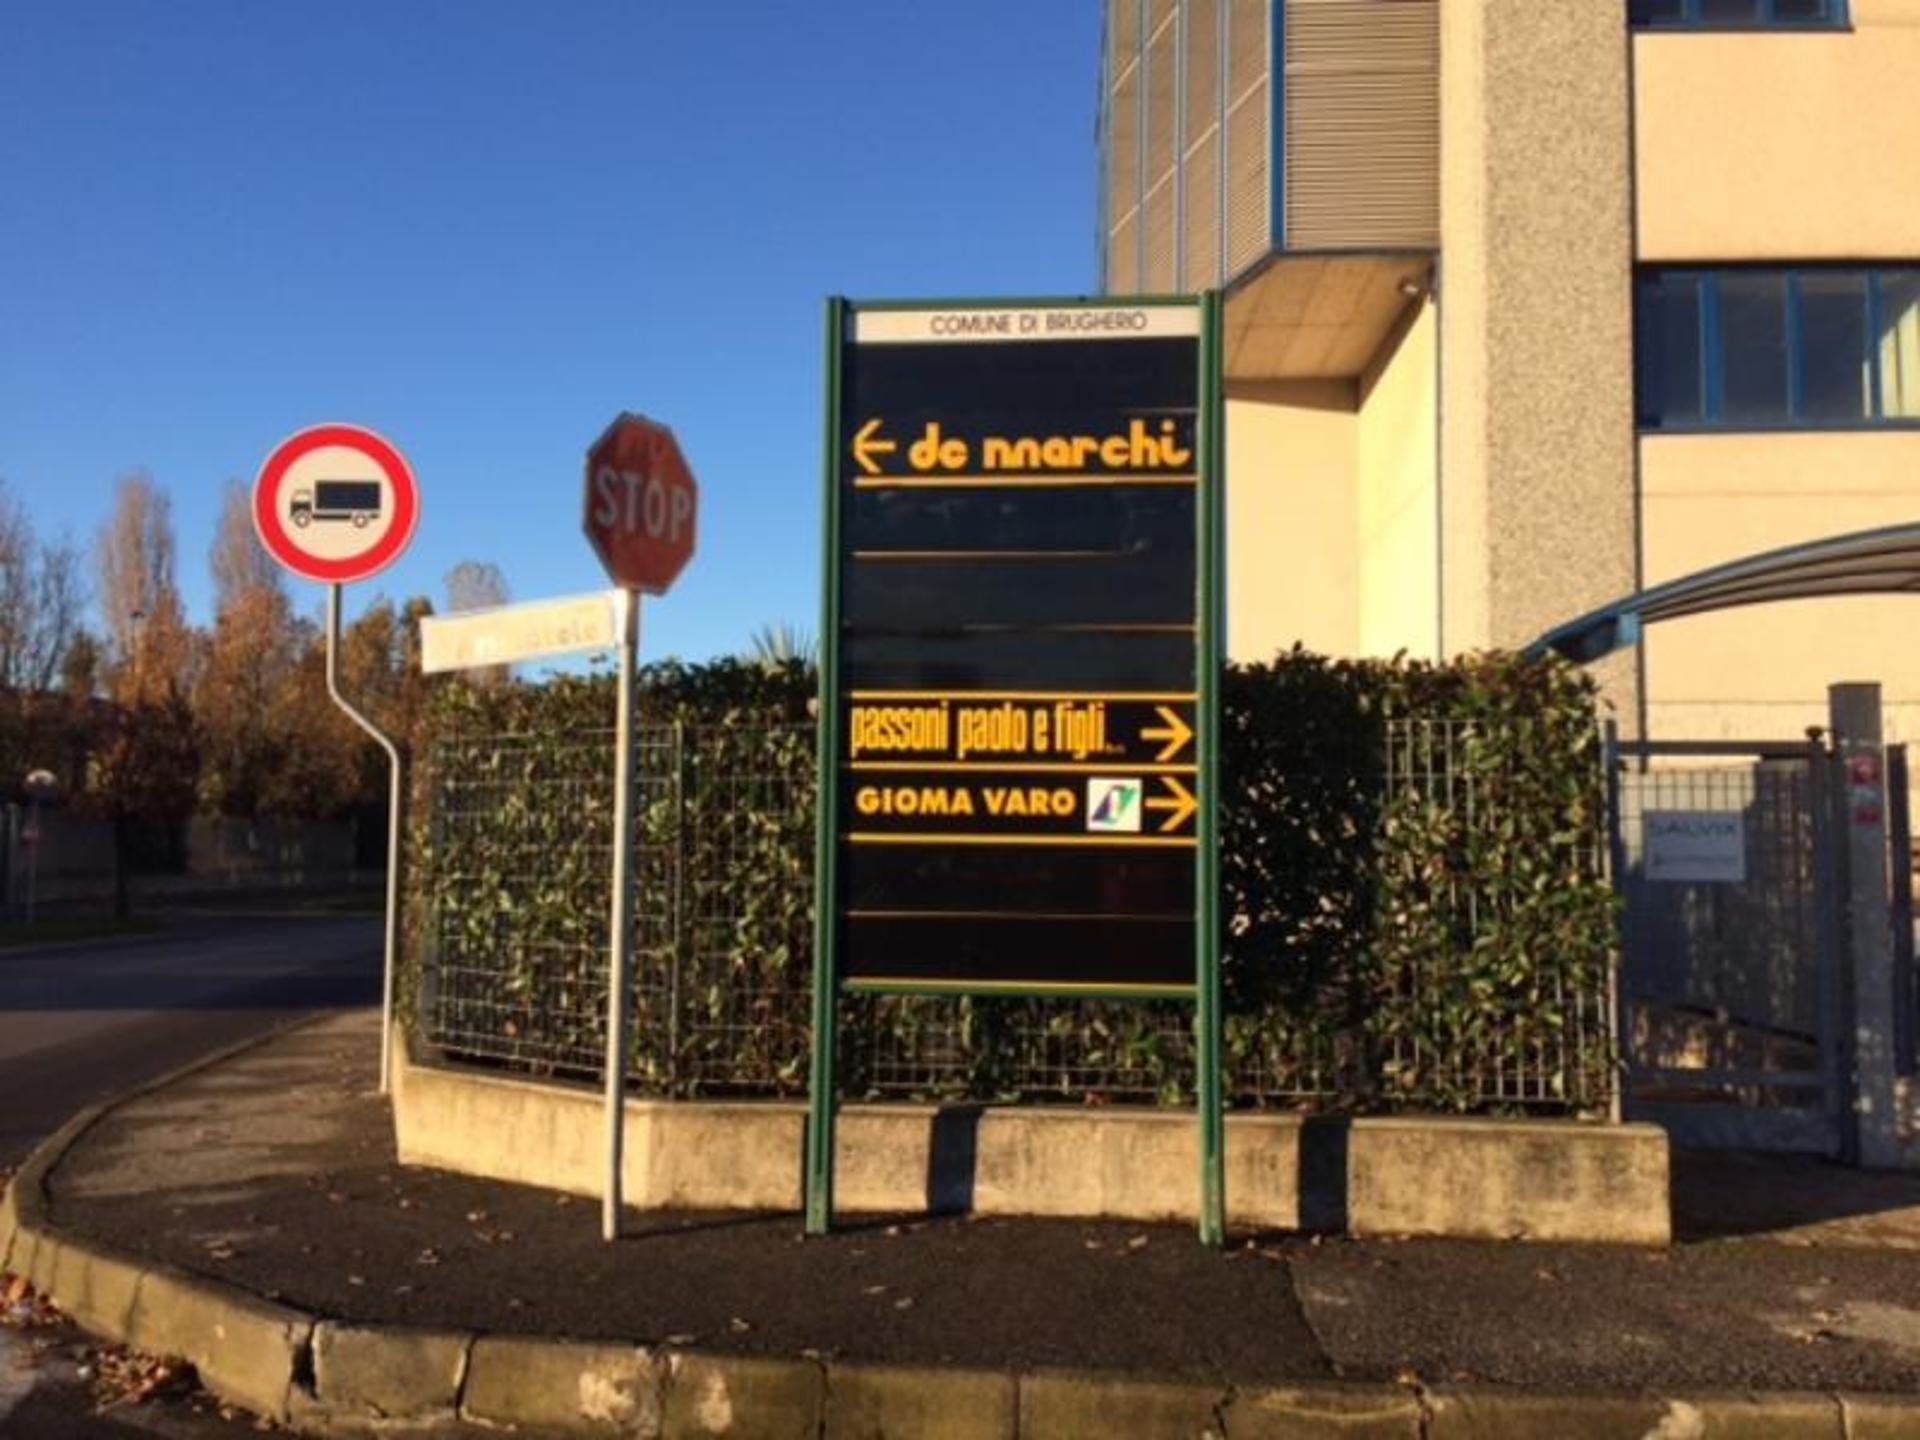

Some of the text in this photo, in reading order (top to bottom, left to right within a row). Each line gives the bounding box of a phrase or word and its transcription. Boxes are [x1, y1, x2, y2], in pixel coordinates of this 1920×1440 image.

[930, 311, 1148, 335] COMUNE DI BRUGHERIO
[982, 419, 1191, 469] marchi
[595, 466, 691, 542] STOP
[851, 700, 1106, 760] passoni paolo e figli
[855, 788, 1076, 816] GIOMA VARO
